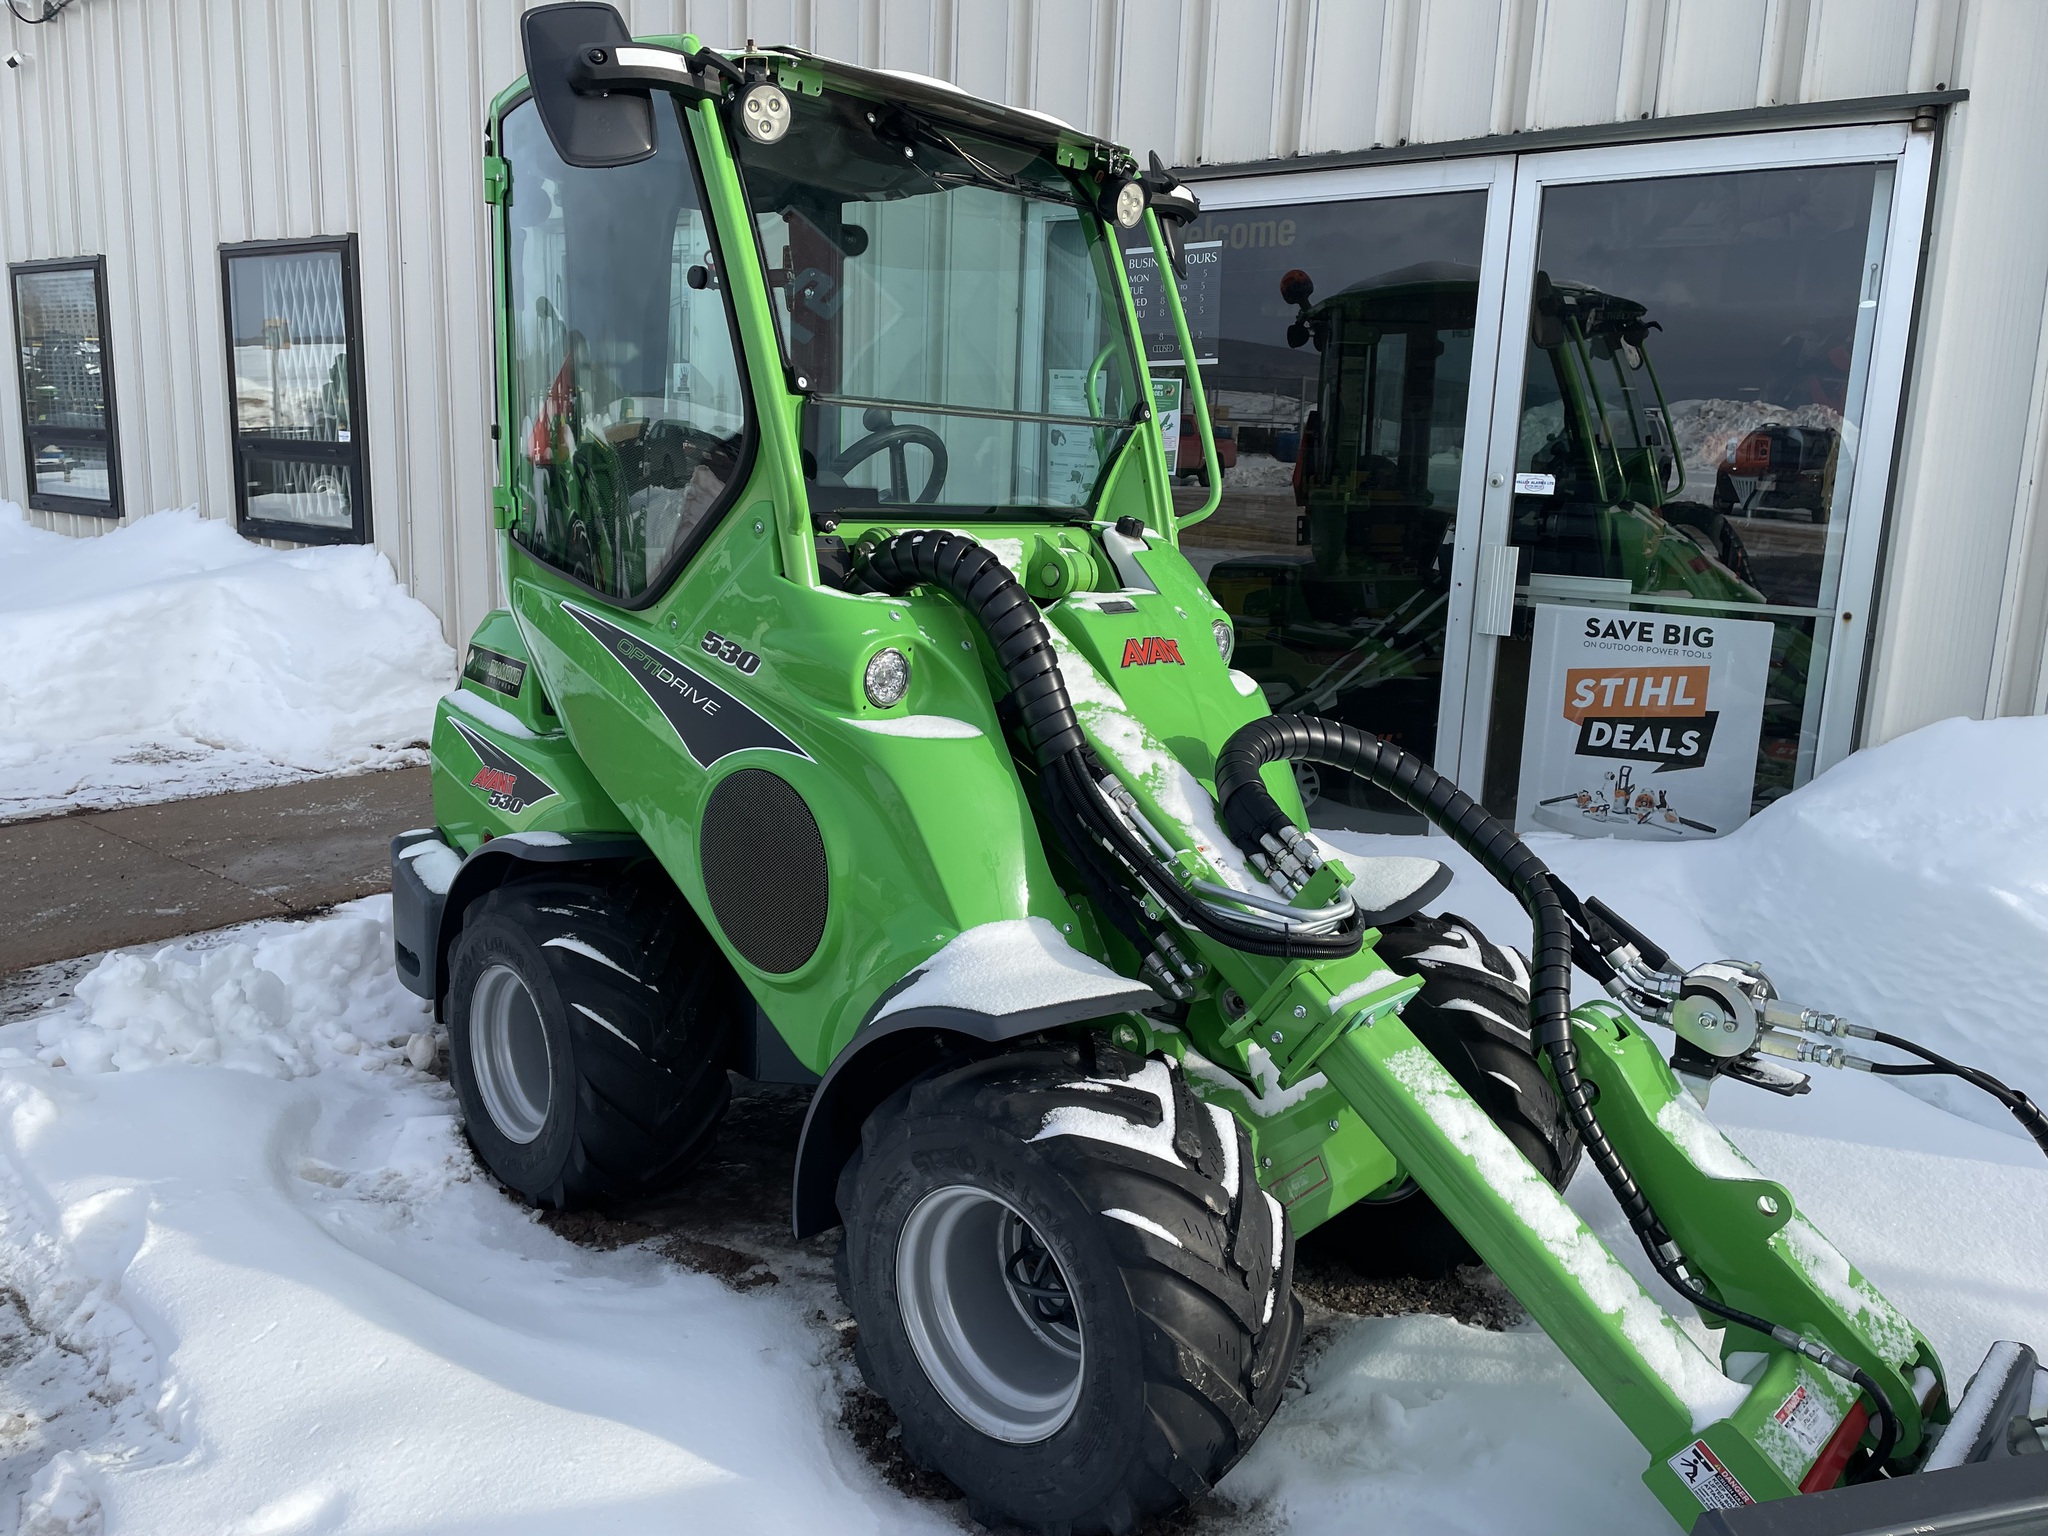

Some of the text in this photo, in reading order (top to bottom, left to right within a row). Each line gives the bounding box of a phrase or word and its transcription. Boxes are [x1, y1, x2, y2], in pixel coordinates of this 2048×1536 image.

[1184, 215, 1297, 250] elcome
[1584, 617, 1715, 649] SAVE BIG
[700, 630, 762, 677] 530
[1583, 640, 1713, 660] ON OUTDOOR POWER TOOLS
[616, 638, 722, 716] OPTIDRIVE
[1571, 675, 1697, 709] STIHL
[1587, 721, 1701, 757] DEALS
[469, 766, 517, 796] AVANT
[487, 790, 526, 816] 530
[1703, 1483, 1726, 1508] ATTACHM
[1707, 1480, 1732, 1508] LIFTED BO
[1712, 1477, 1726, 1492] KEEP
[1721, 1471, 1750, 1503] DANGER
[1733, 1492, 1745, 1506] HAZ
